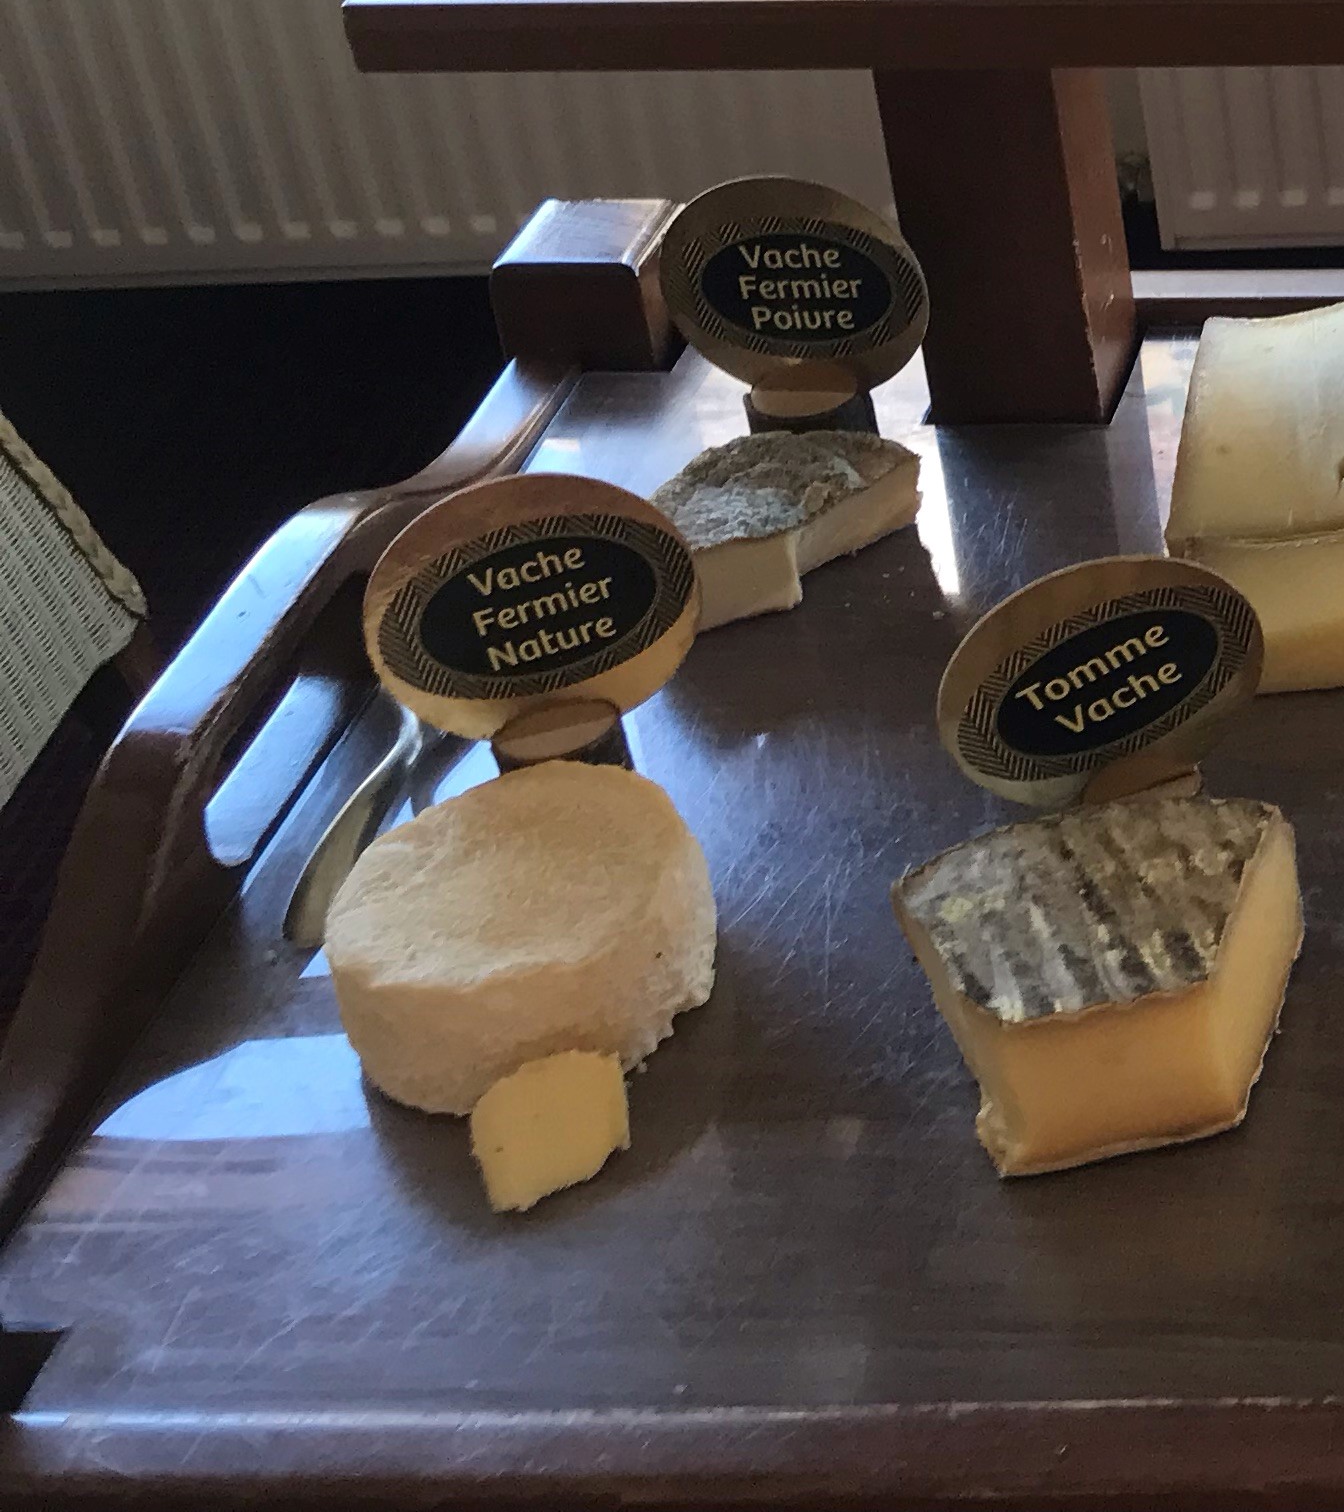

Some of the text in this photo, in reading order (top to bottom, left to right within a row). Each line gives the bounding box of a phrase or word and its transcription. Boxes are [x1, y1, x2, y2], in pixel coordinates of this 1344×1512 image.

[739, 244, 841, 269] Vache
[739, 274, 862, 300] Fermier
[752, 305, 855, 330] Poivre
[467, 545, 585, 597] Vache
[472, 574, 613, 637] Fermier
[487, 614, 616, 672] Nature
[1015, 624, 1170, 711] Tomme
[1055, 659, 1182, 735] Vache
